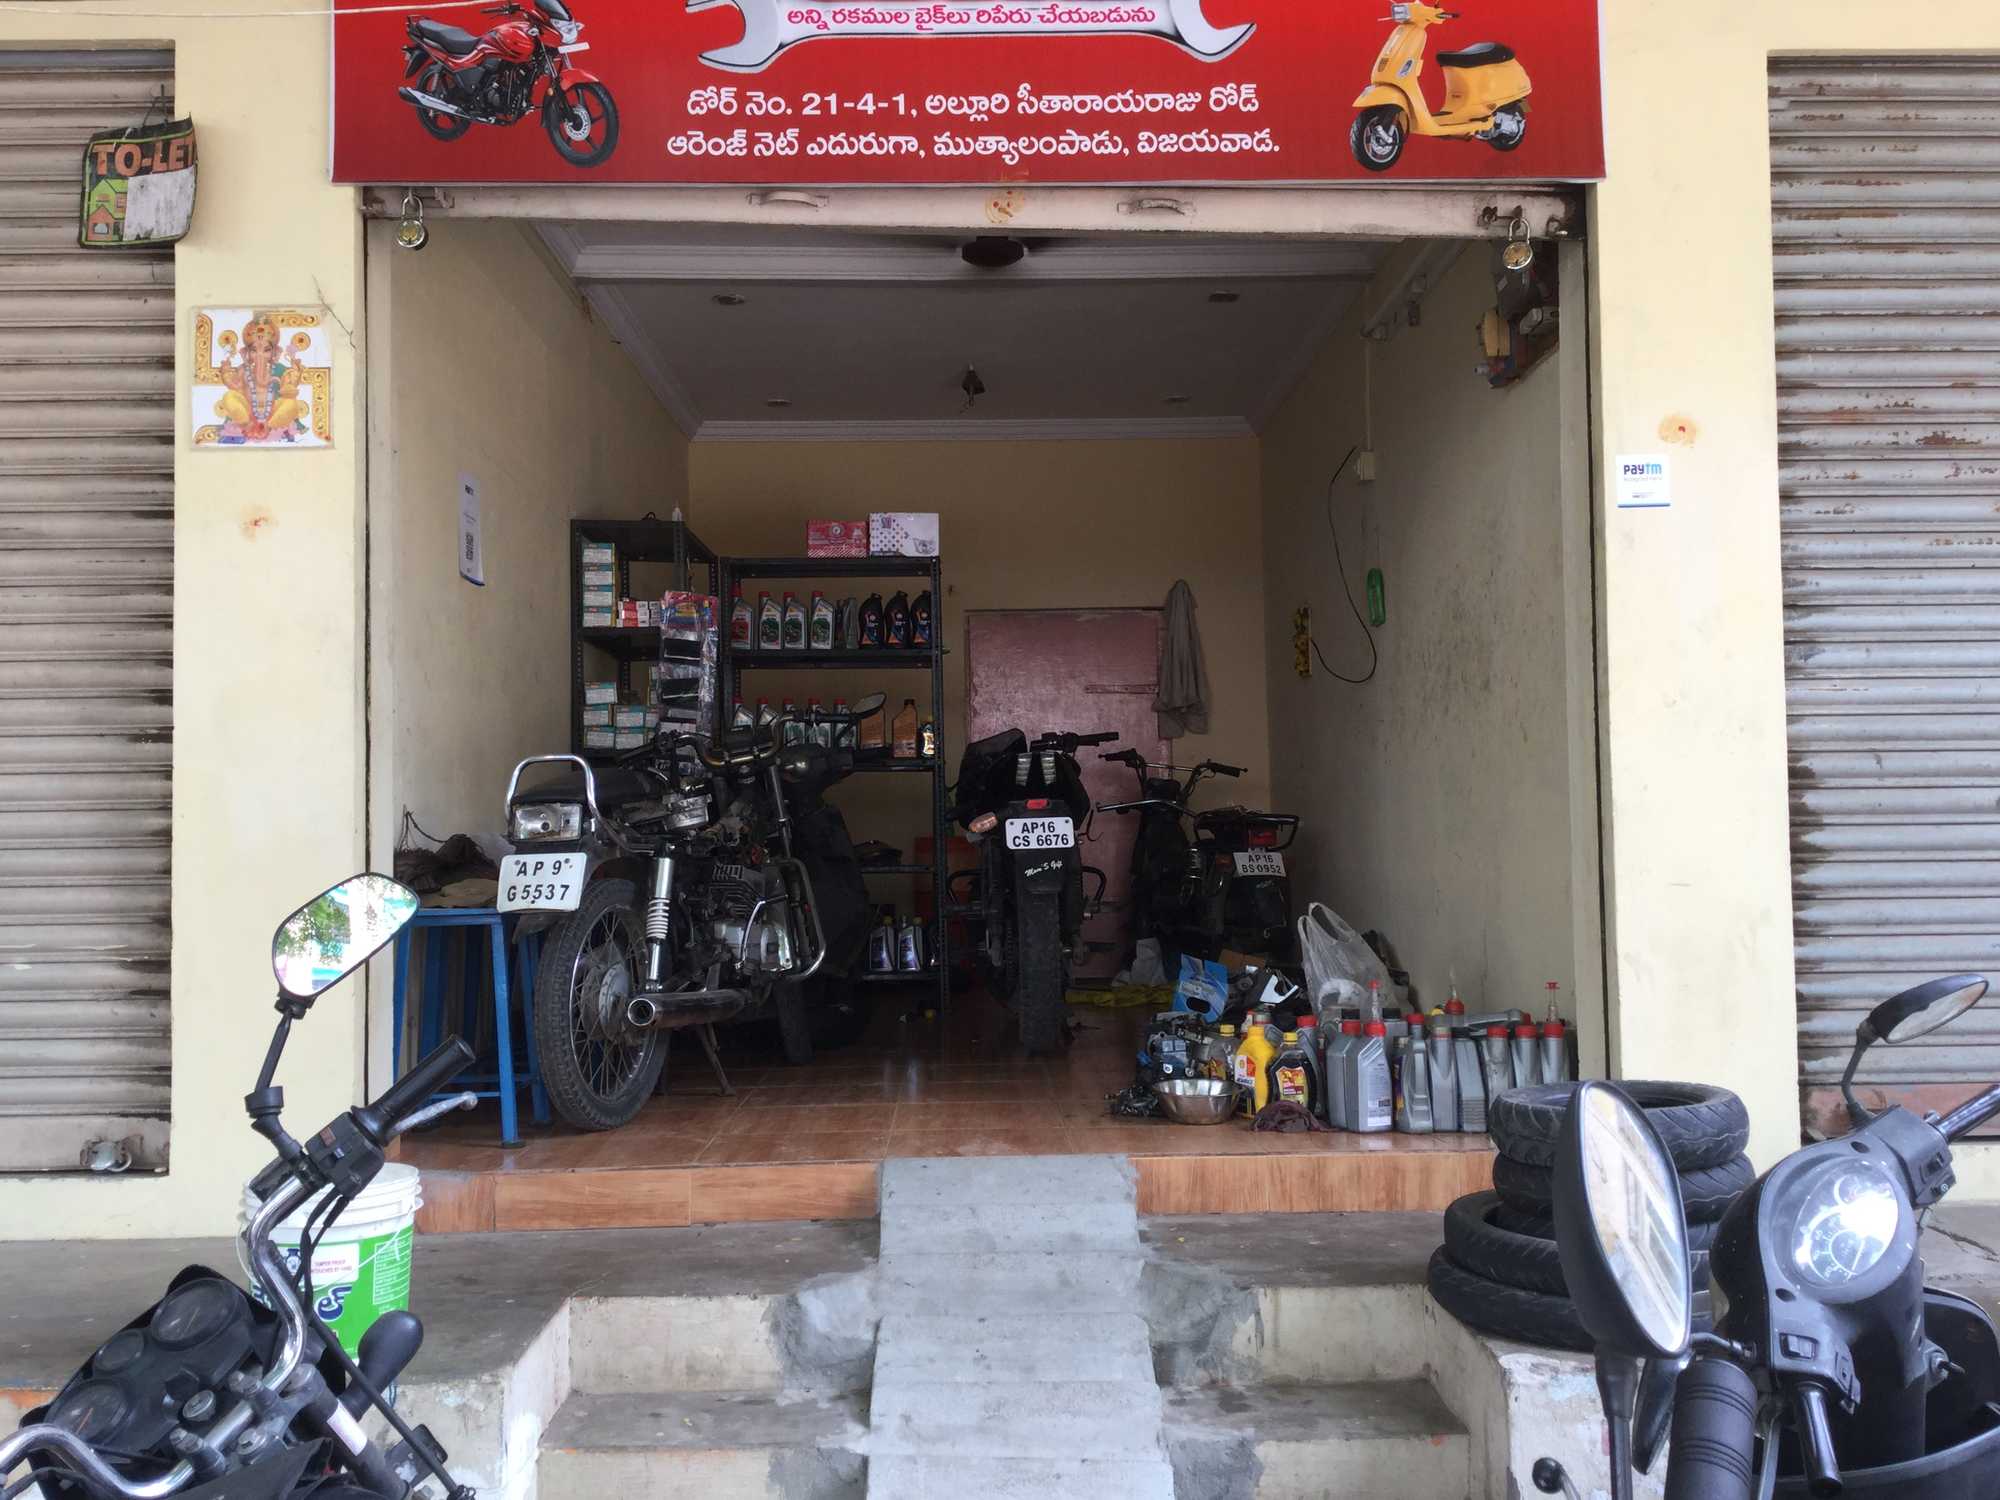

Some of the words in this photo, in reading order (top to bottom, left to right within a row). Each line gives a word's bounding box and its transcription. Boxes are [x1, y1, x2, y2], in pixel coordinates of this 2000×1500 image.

[787, 8, 831, 31] అన్ని
[832, 8, 910, 25] రకముల
[975, 4, 1032, 25] రిపేరు
[1036, 4, 1156, 24] చేయబడును
[686, 86, 738, 116] డోర్
[745, 91, 793, 116] నెం.
[801, 92, 918, 118] 21-4-1,
[924, 91, 1010, 123] అల్లూరి
[1208, 83, 1260, 113] రోడ్
[666, 128, 748, 157] ఆరెంజ్
[753, 128, 800, 157] నెట్
[806, 131, 926, 159] ఎదురుగా,
[932, 128, 1130, 166] ముత్యాలంపాడు,
[1136, 127, 1281, 154] విజయవాడ.
[1012, 835, 1031, 848] CS
[1036, 833, 1069, 847] 6676
[1021, 821, 1056, 834] AP16
